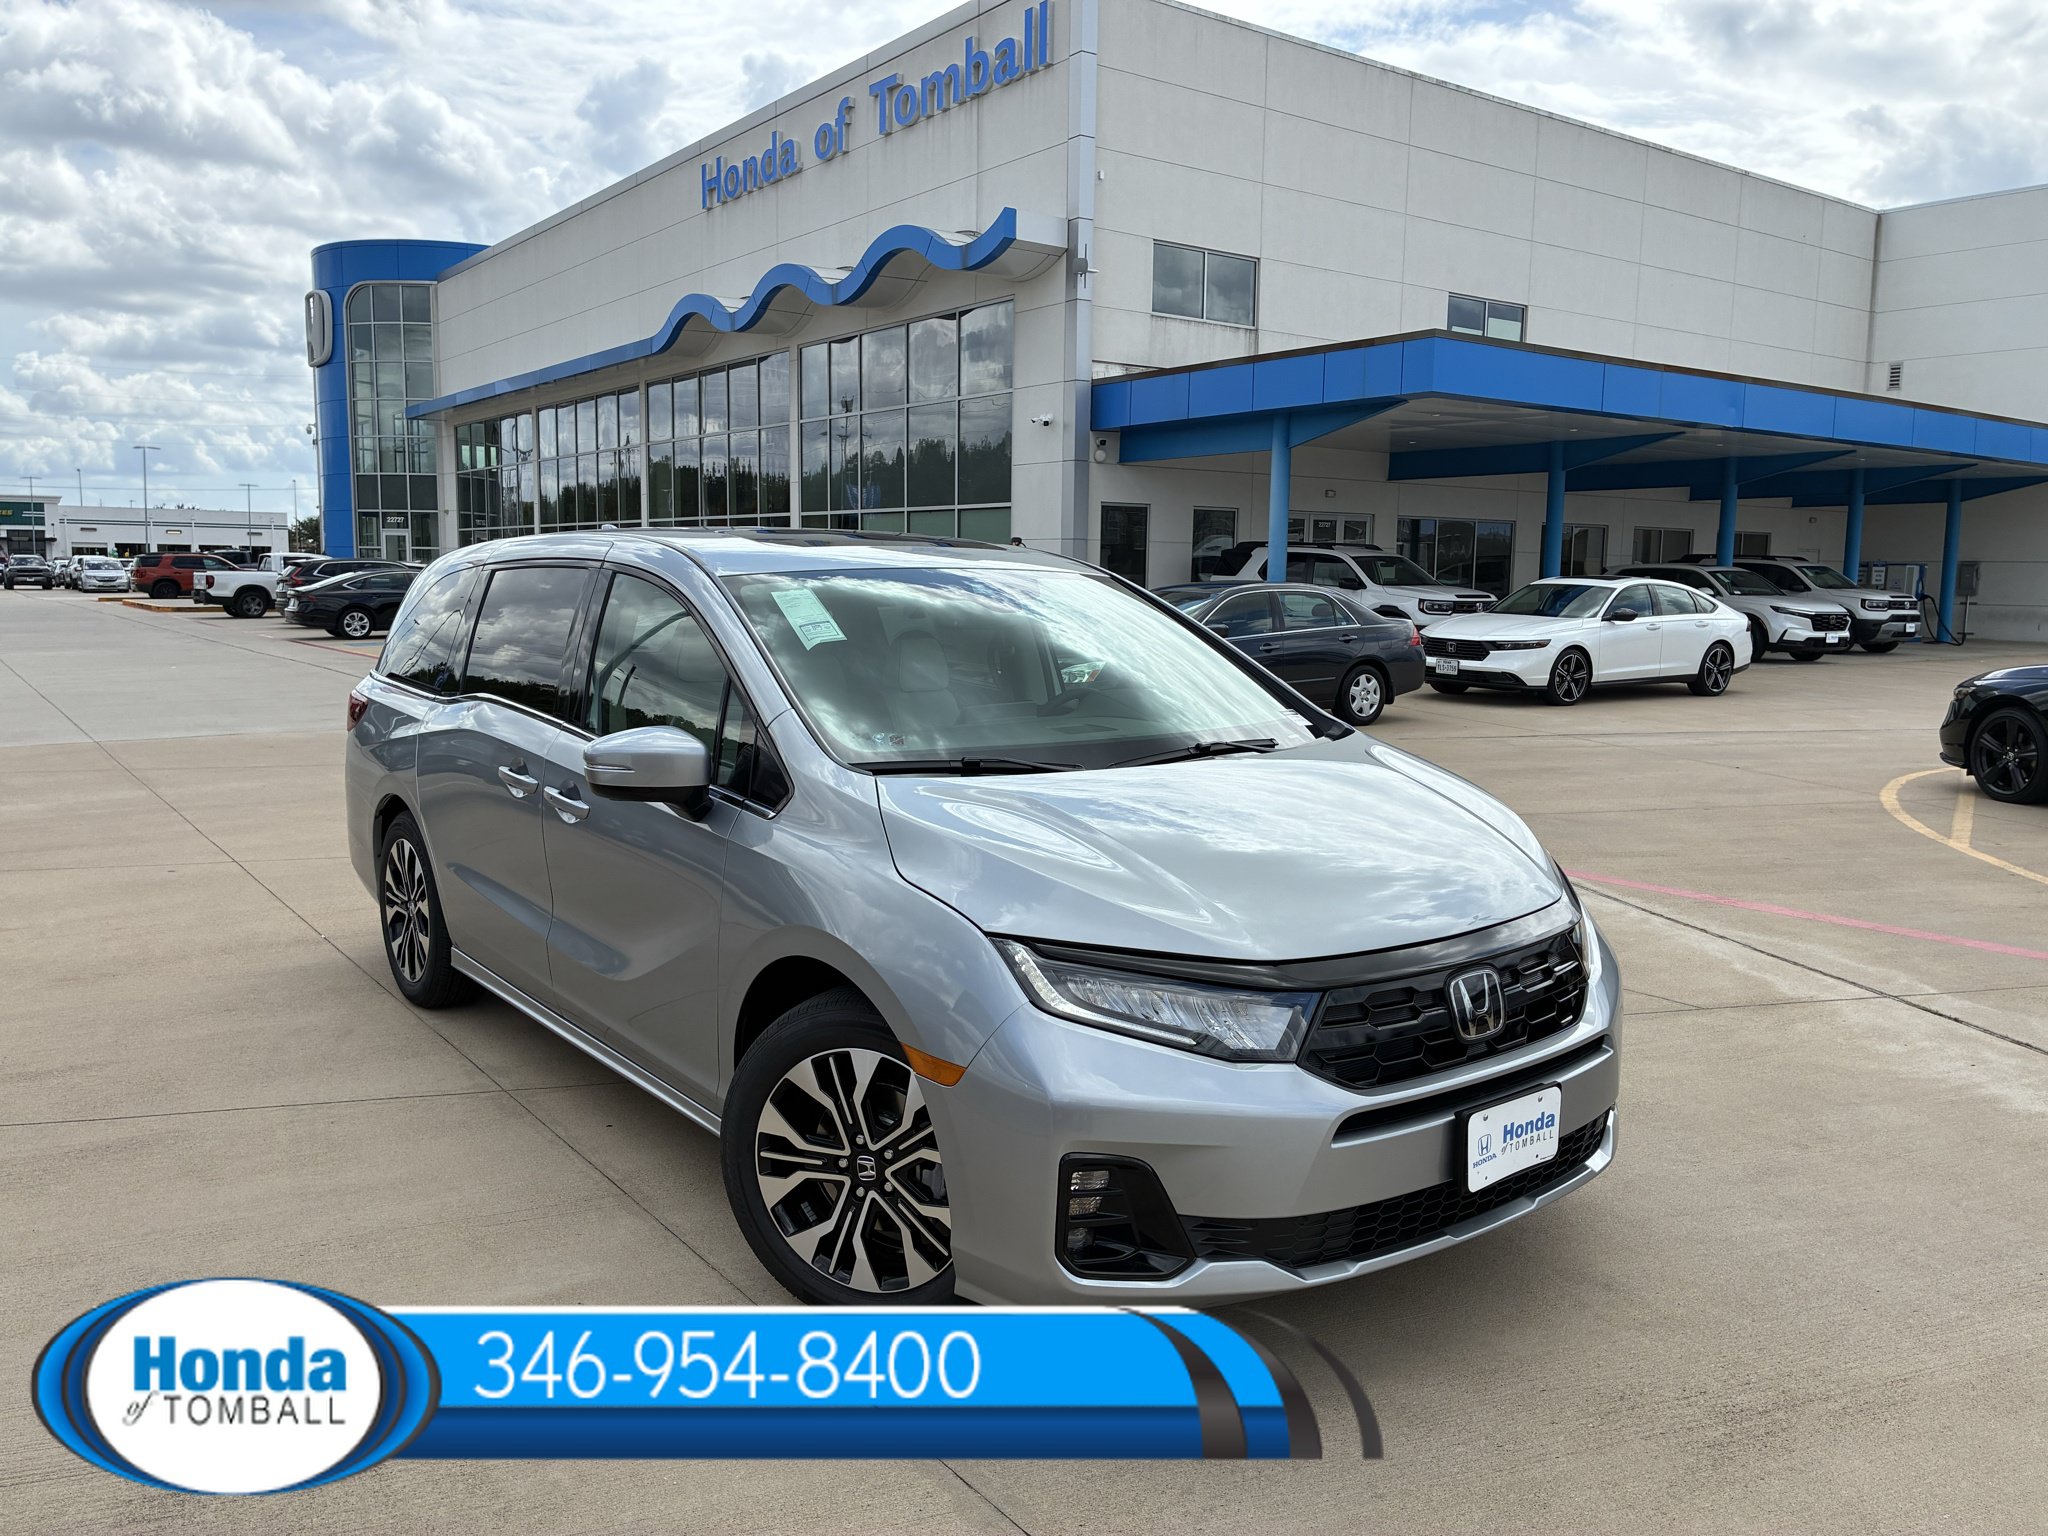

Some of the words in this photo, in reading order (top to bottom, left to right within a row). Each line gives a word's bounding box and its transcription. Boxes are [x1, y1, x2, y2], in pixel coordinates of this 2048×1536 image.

[701, 130, 801, 210] Honda
[814, 96, 855, 161] of
[869, 0, 1054, 135] Tomball
[1501, 1141, 1509, 1155] of
[1510, 1129, 1554, 1153] TOMBALL
[1503, 1111, 1556, 1144] Honda
[1473, 1153, 1497, 1169] HONDA
